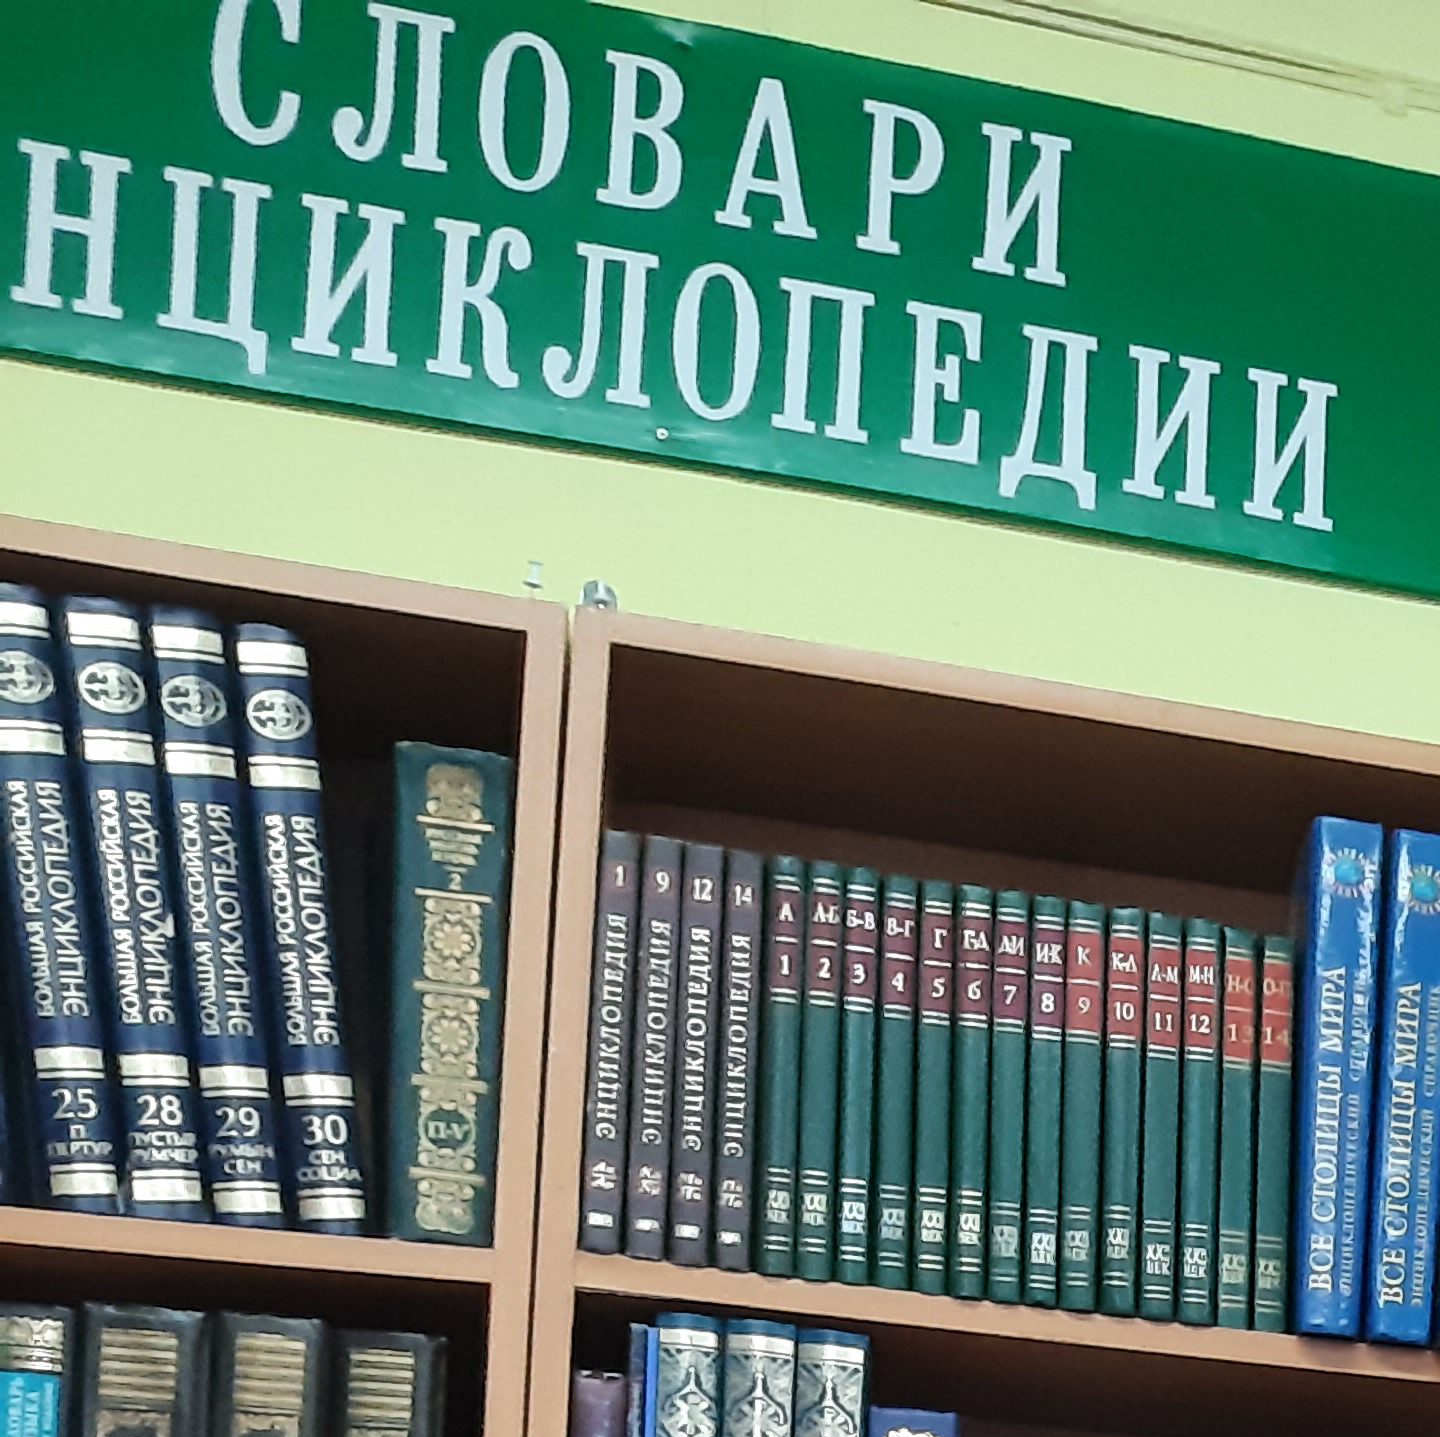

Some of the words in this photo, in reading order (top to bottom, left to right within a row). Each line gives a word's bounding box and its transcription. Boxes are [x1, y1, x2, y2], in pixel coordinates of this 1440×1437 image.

[210, 0, 1073, 287] СЛОВАРИ
[10, 138, 1341, 533] НЦИКЛОПЕДИИ
[7, 780, 41, 913] РОССИЙСКАЯ
[97, 789, 131, 923] РОССИЙСКАЯ
[180, 801, 212, 934] РОССИЙСКАЯ
[34, 781, 89, 1017] ЭНЦИКЛОПЕДИЯ
[264, 814, 298, 946] РОССИЙСКАЯ
[615, 866, 625, 887] 1
[655, 870, 670, 893] 9
[692, 878, 712, 902] 12
[734, 884, 752, 906] 14
[126, 790, 177, 1024] ЭНЦИКЛОПЕДИЯ
[205, 804, 253, 1037] ЭНЦИКЛОПЕДИЯ
[291, 814, 340, 1046] ЭНЦИКЛОПЕДИЯ
[780, 955, 790, 975] 1
[934, 929, 948, 948] Г
[1077, 946, 1092, 967] К
[26, 921, 54, 1018] БОЛЬШАЯ
[112, 928, 144, 1024] БОЛЬШАЯ
[195, 941, 221, 1037] БОЛЬШАЯ
[818, 957, 831, 979] 2
[852, 964, 866, 984] 3
[892, 972, 904, 992] 4
[931, 977, 945, 997] 5
[967, 981, 981, 999] 6
[1004, 985, 1017, 1005] 7
[279, 951, 308, 1046] БОЛЬШАЯ
[1041, 993, 1055, 1013] 8
[1078, 997, 1091, 1015] 9
[1114, 1002, 1135, 1021] 10
[1154, 1012, 1172, 1032] 11
[1190, 1015, 1211, 1033] 12
[1322, 966, 1347, 1052] МИРА
[1402, 982, 1422, 1068] МИРА
[595, 914, 628, 1140] ЭНЦИКЛОПЕДИЯ
[641, 919, 672, 1145] ЭНЦИКЛОПЕДИЯ
[681, 927, 712, 1152] ЭНЦИКЛОПЕДИЯ
[723, 934, 751, 1158] ЭНЦИКЛОПЕДИЯ
[1228, 1025, 1253, 1042] 13
[1264, 1027, 1290, 1045] 14
[52, 1088, 98, 1119] 25
[138, 1095, 184, 1126] 28
[214, 1106, 261, 1137] 29
[303, 1115, 348, 1145] 30
[1312, 1066, 1343, 1230] СТОЛИЦЫ
[1383, 1078, 1417, 1242] СТОЛИЦЫ
[1339, 1094, 1363, 1296] ЭНЦИКЛОПЕДИЧЕСКИЙ
[1412, 1110, 1433, 1307] ЭНЦИКЛОПЕДИЧЕСКИЙ
[1308, 1238, 1332, 1294] ВСЕ
[1379, 1249, 1405, 1304] ВСЕ
